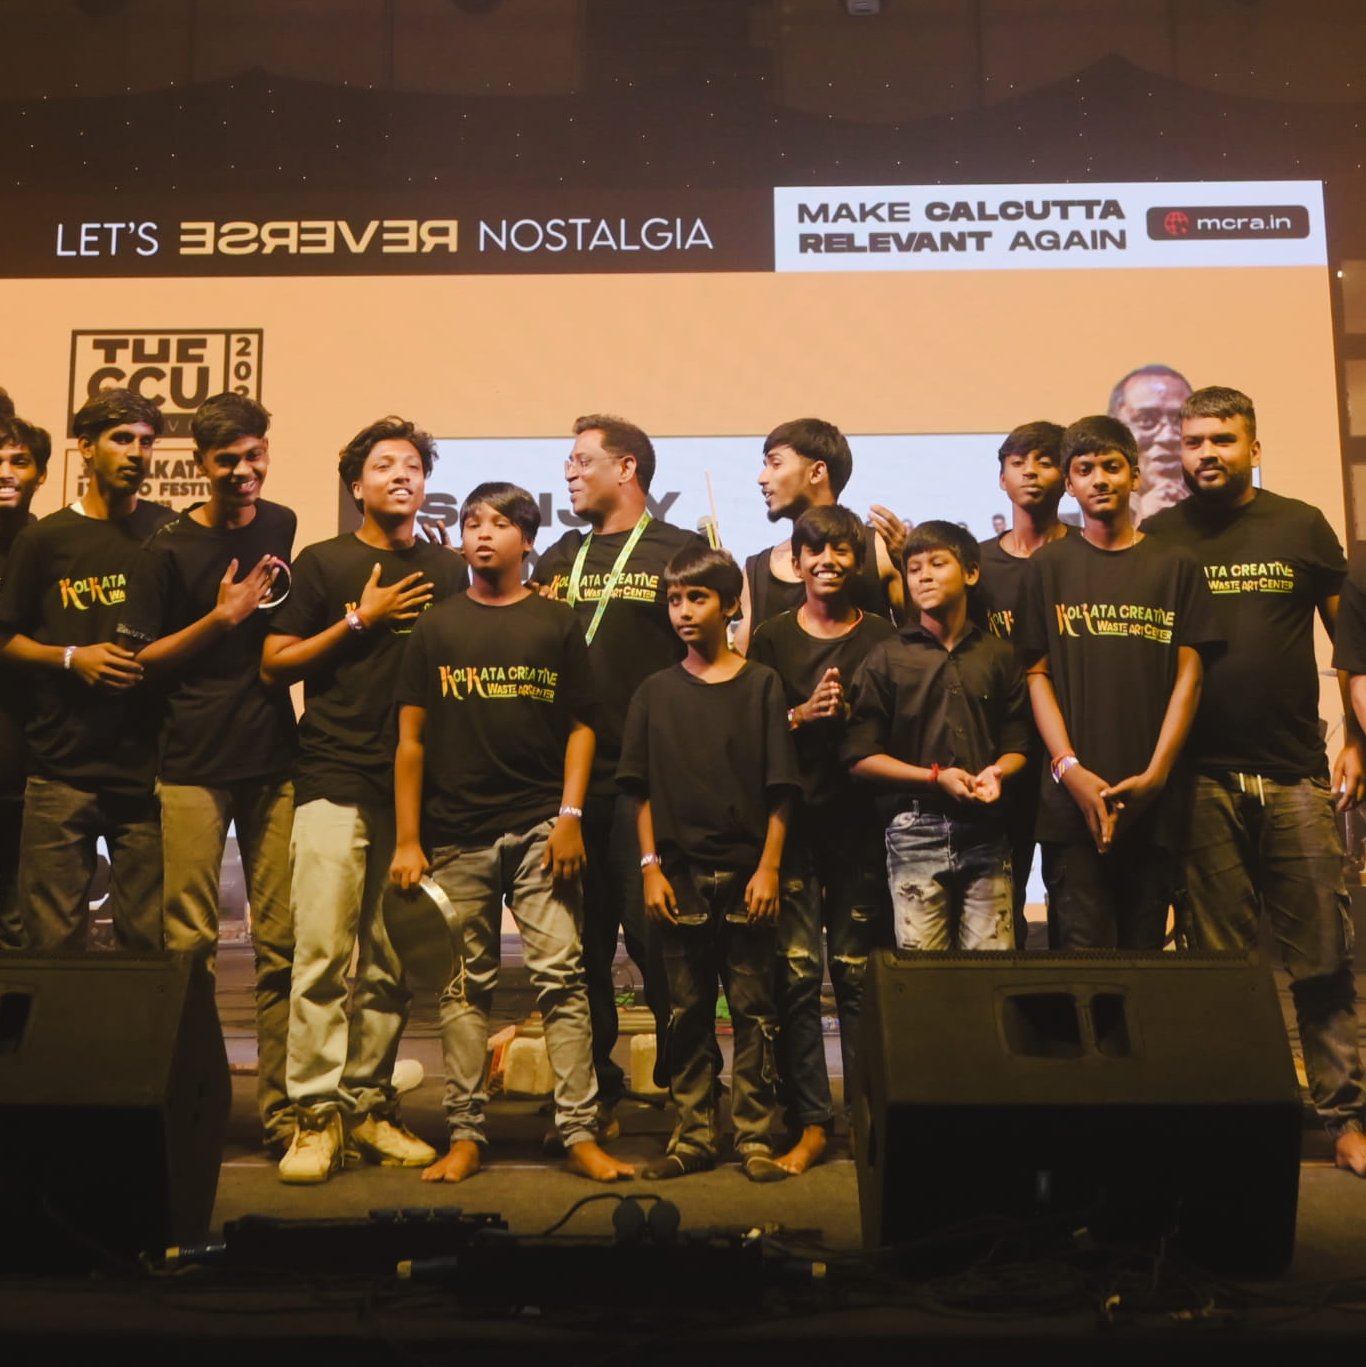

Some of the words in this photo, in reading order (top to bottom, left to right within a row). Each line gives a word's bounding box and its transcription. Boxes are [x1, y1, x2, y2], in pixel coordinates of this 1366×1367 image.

[797, 203, 910, 223] MAKE
[924, 199, 1126, 222] CALCUTTA
[1196, 212, 1291, 231] mcra.in
[56, 221, 159, 257] LET'S
[479, 217, 714, 252] NOSTALGIA
[799, 231, 992, 254] RELEVANT
[1008, 229, 1127, 251] AGAIN
[92, 338, 207, 363] THE
[1230, 561, 1294, 577] CREATIVE
[59, 574, 126, 610] KOLKATA
[1208, 580, 1241, 592] WASTE
[1097, 620, 1129, 634] WASTE
[1119, 605, 1176, 627] CREATIVE
[438, 666, 506, 701] KOLKATA
[487, 683, 517, 696] WASTE
